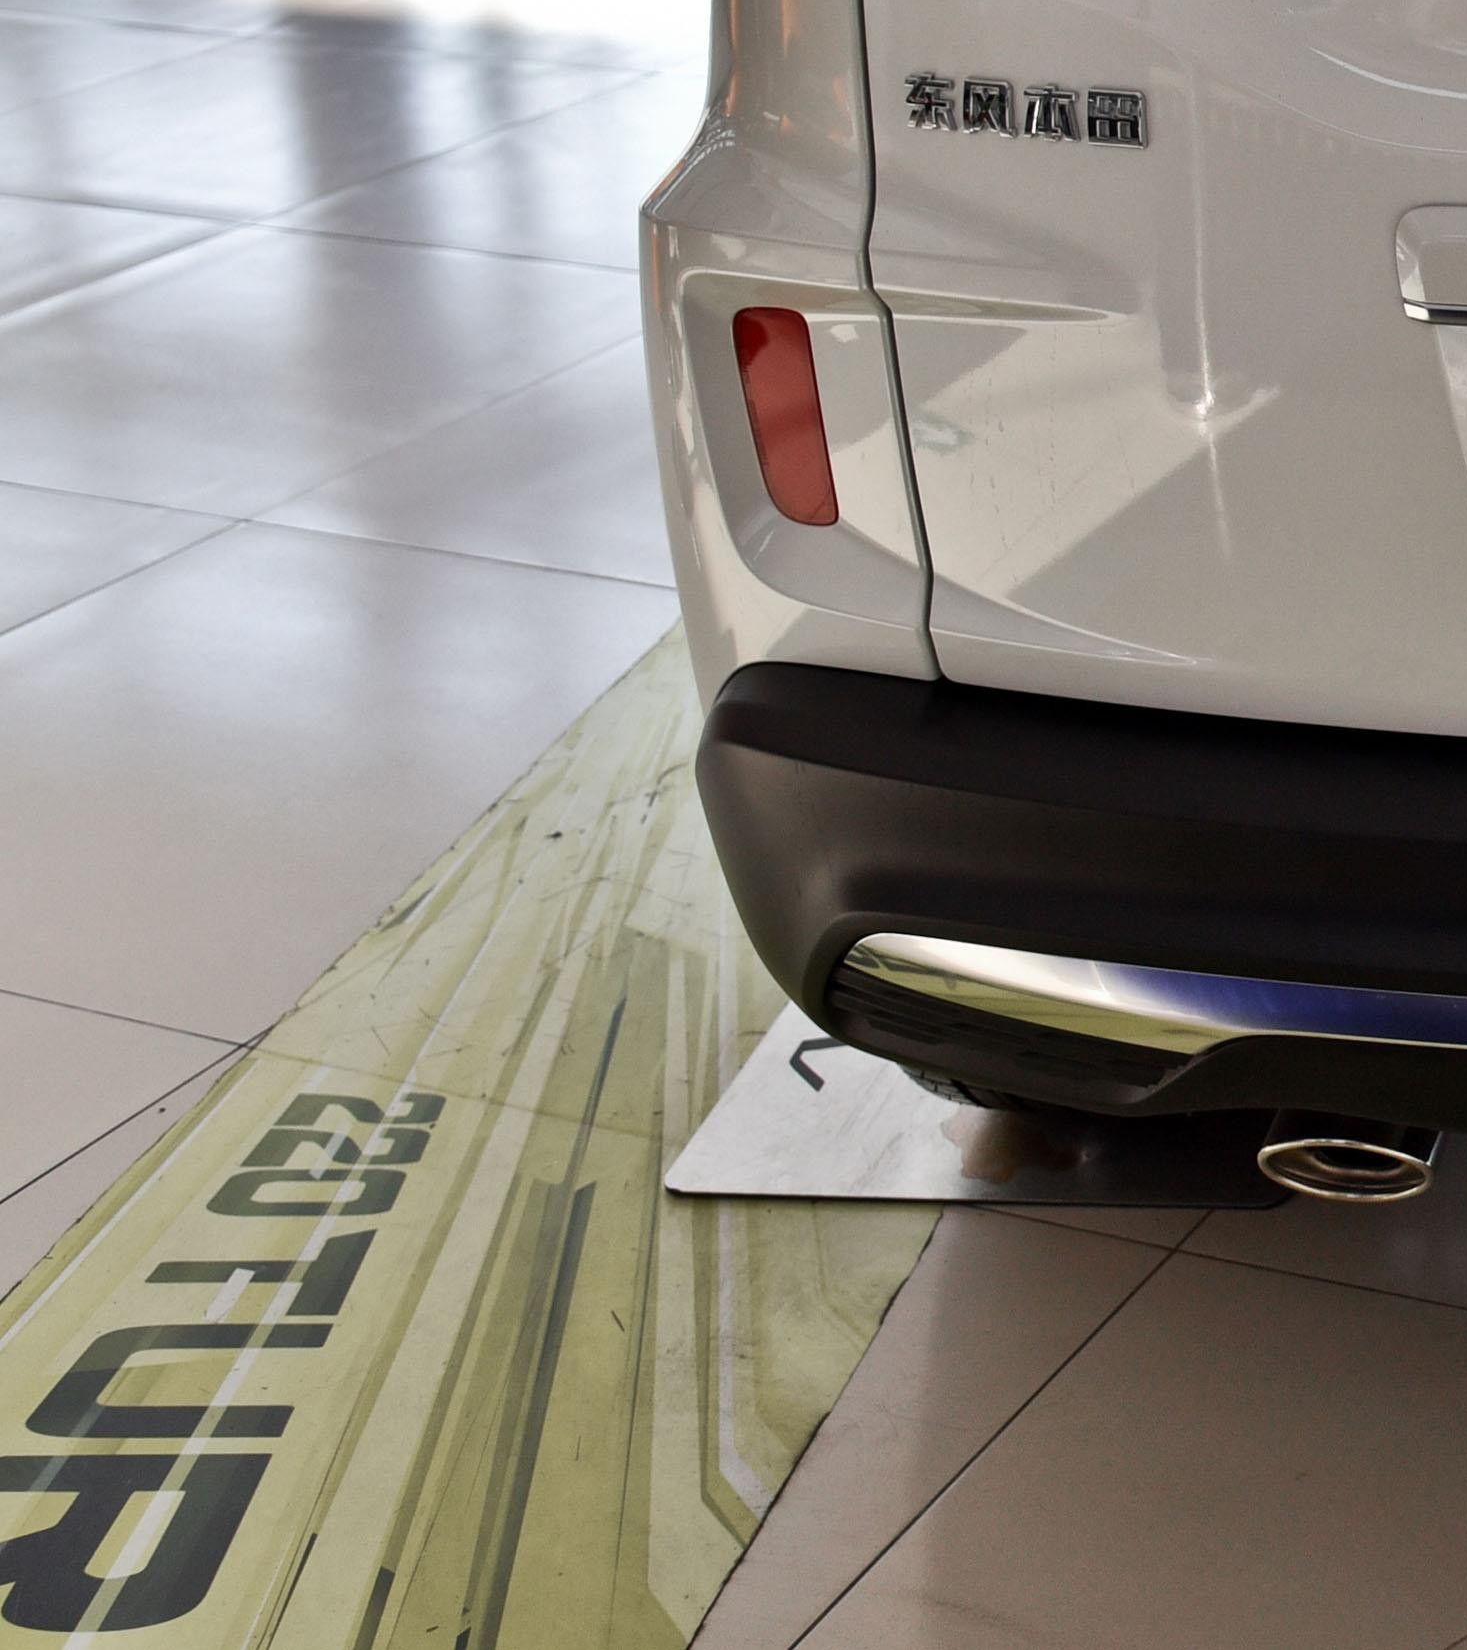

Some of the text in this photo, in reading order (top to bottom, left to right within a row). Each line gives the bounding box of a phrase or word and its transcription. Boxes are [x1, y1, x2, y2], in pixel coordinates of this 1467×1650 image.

[904, 71, 1150, 150] 东风本田
[204, 1091, 448, 1218] 220
